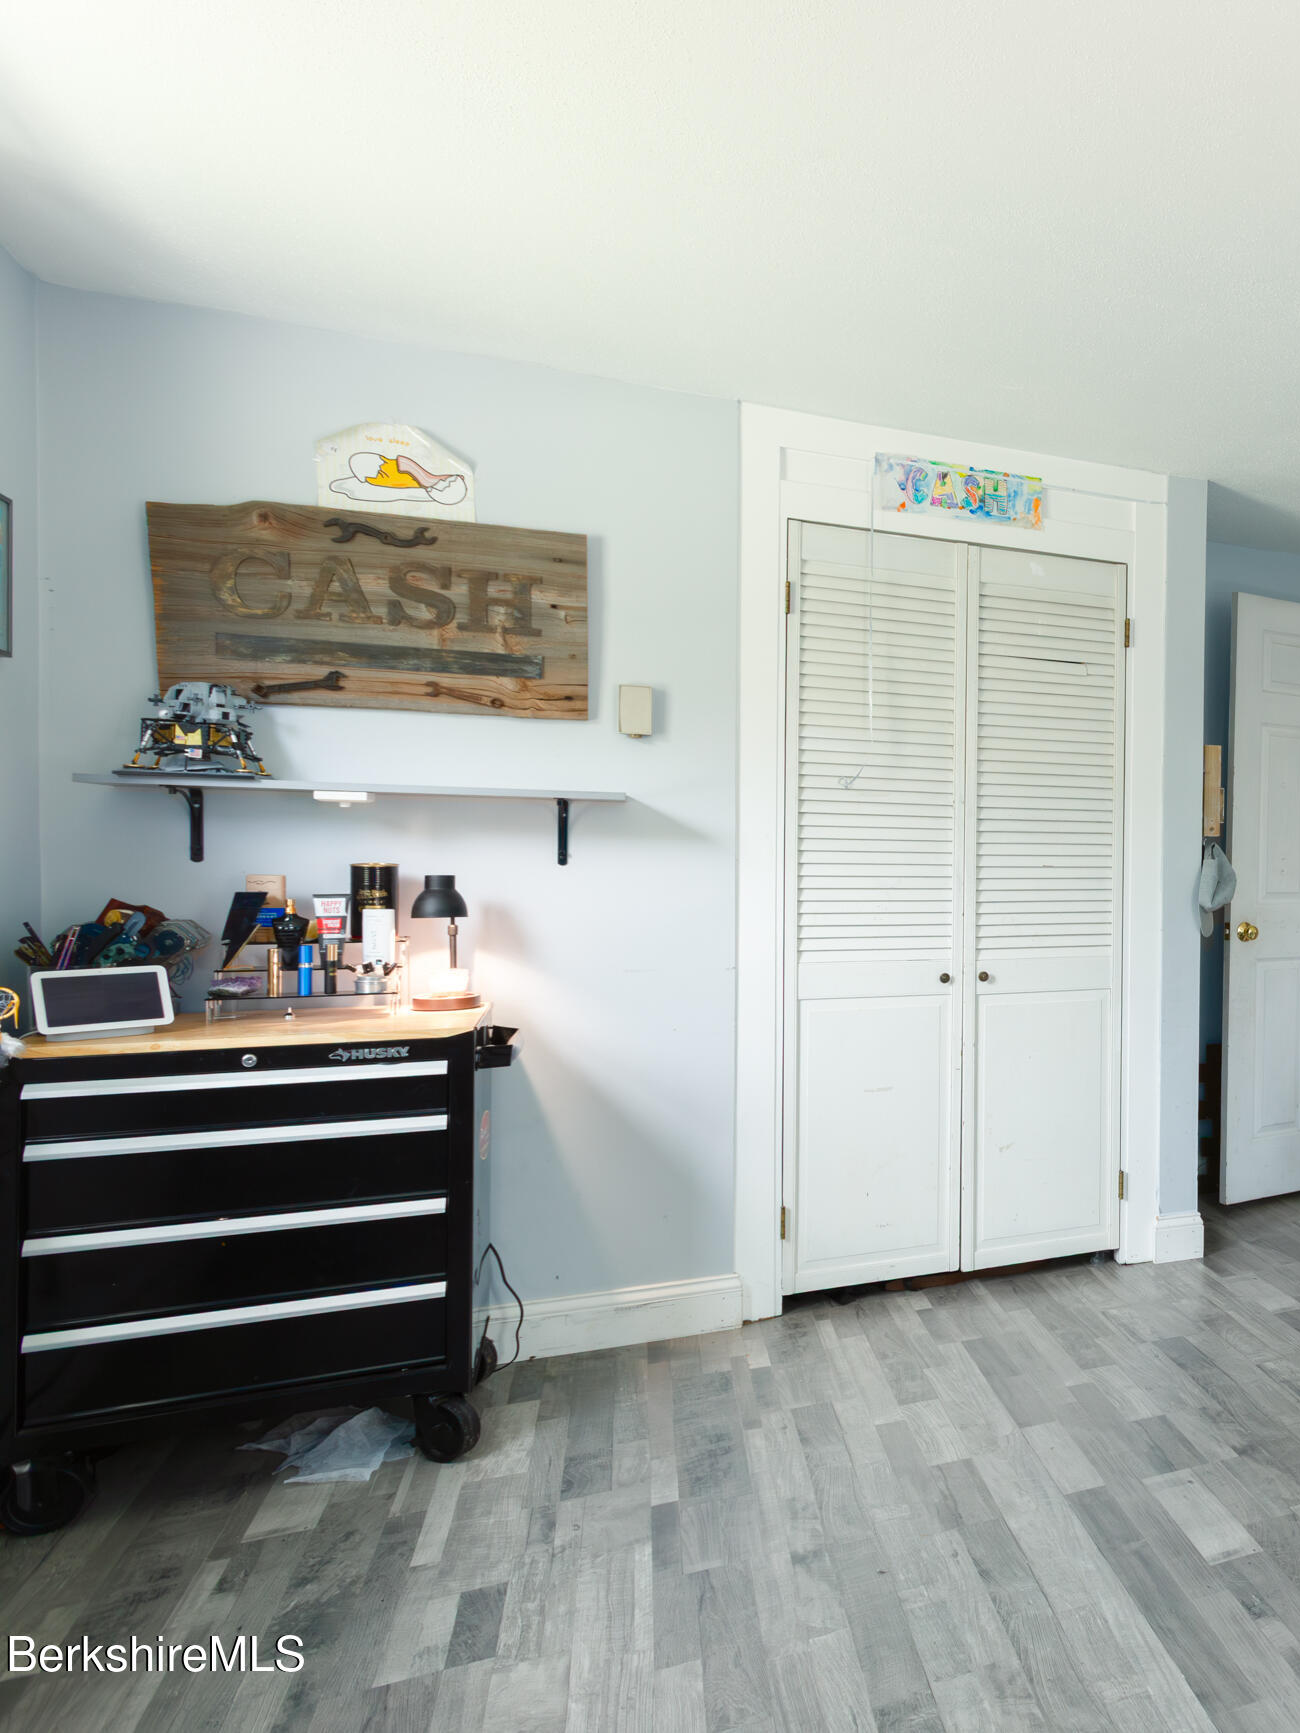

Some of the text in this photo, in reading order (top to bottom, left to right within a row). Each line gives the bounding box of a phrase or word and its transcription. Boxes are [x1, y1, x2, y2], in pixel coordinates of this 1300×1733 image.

[905, 465, 1009, 515] CASH
[208, 549, 544, 637] CASH
[350, 1046, 410, 1060] HUSKY
